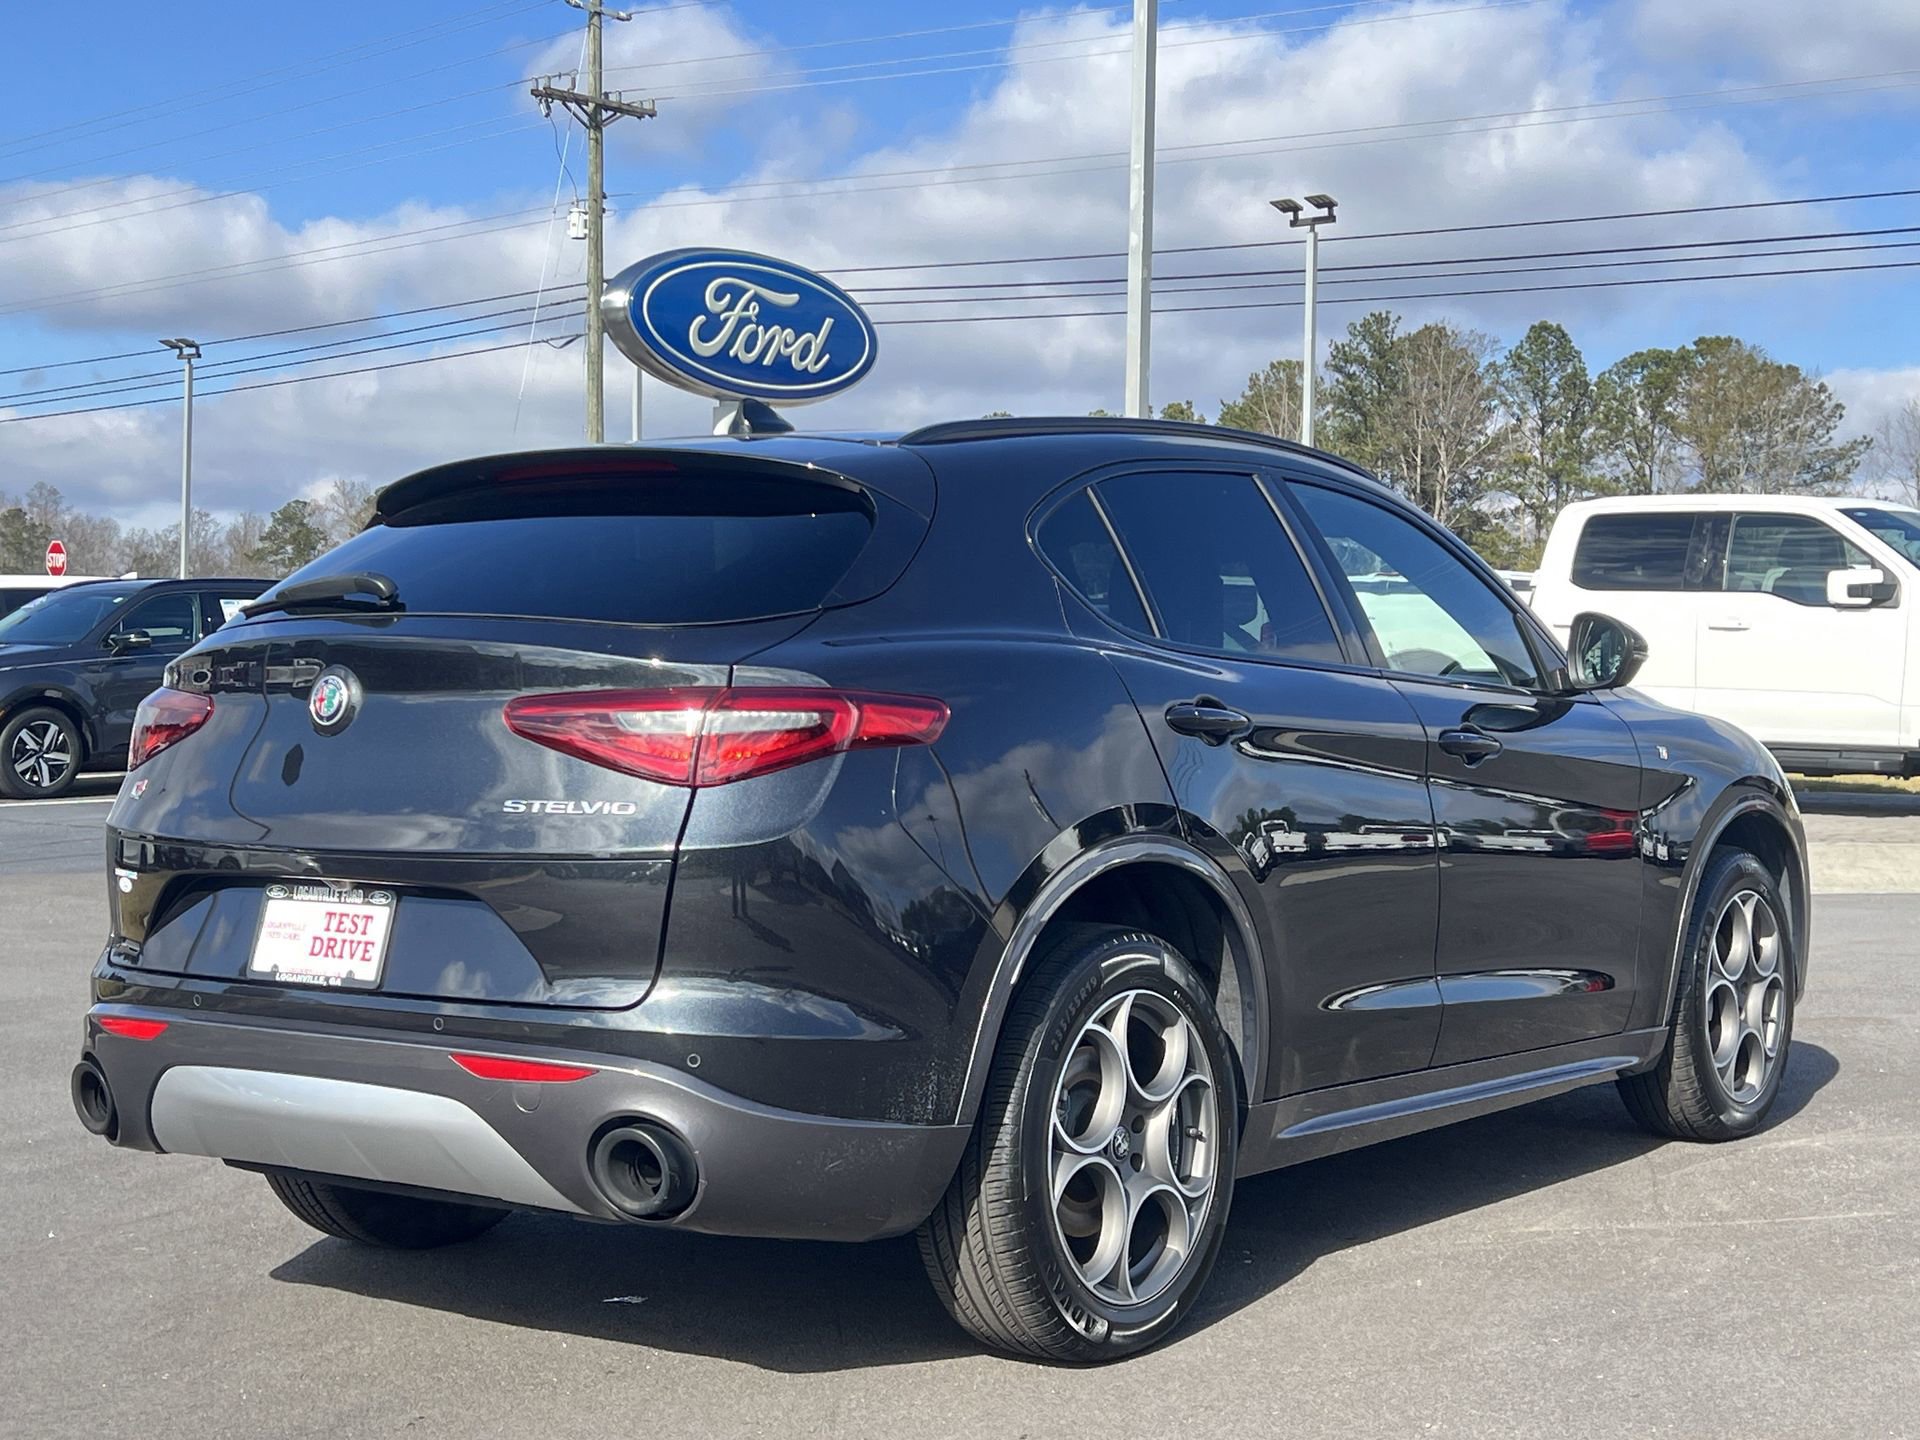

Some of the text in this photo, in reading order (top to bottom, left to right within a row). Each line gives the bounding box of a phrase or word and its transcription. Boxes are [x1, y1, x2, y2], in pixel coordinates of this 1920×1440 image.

[689, 277, 835, 374] Ford
[48, 552, 65, 568] STOP
[503, 800, 637, 815] STELVIO
[292, 885, 340, 903] LOGANVILLE
[324, 911, 374, 936] TEST
[309, 936, 375, 962] DRIVE
